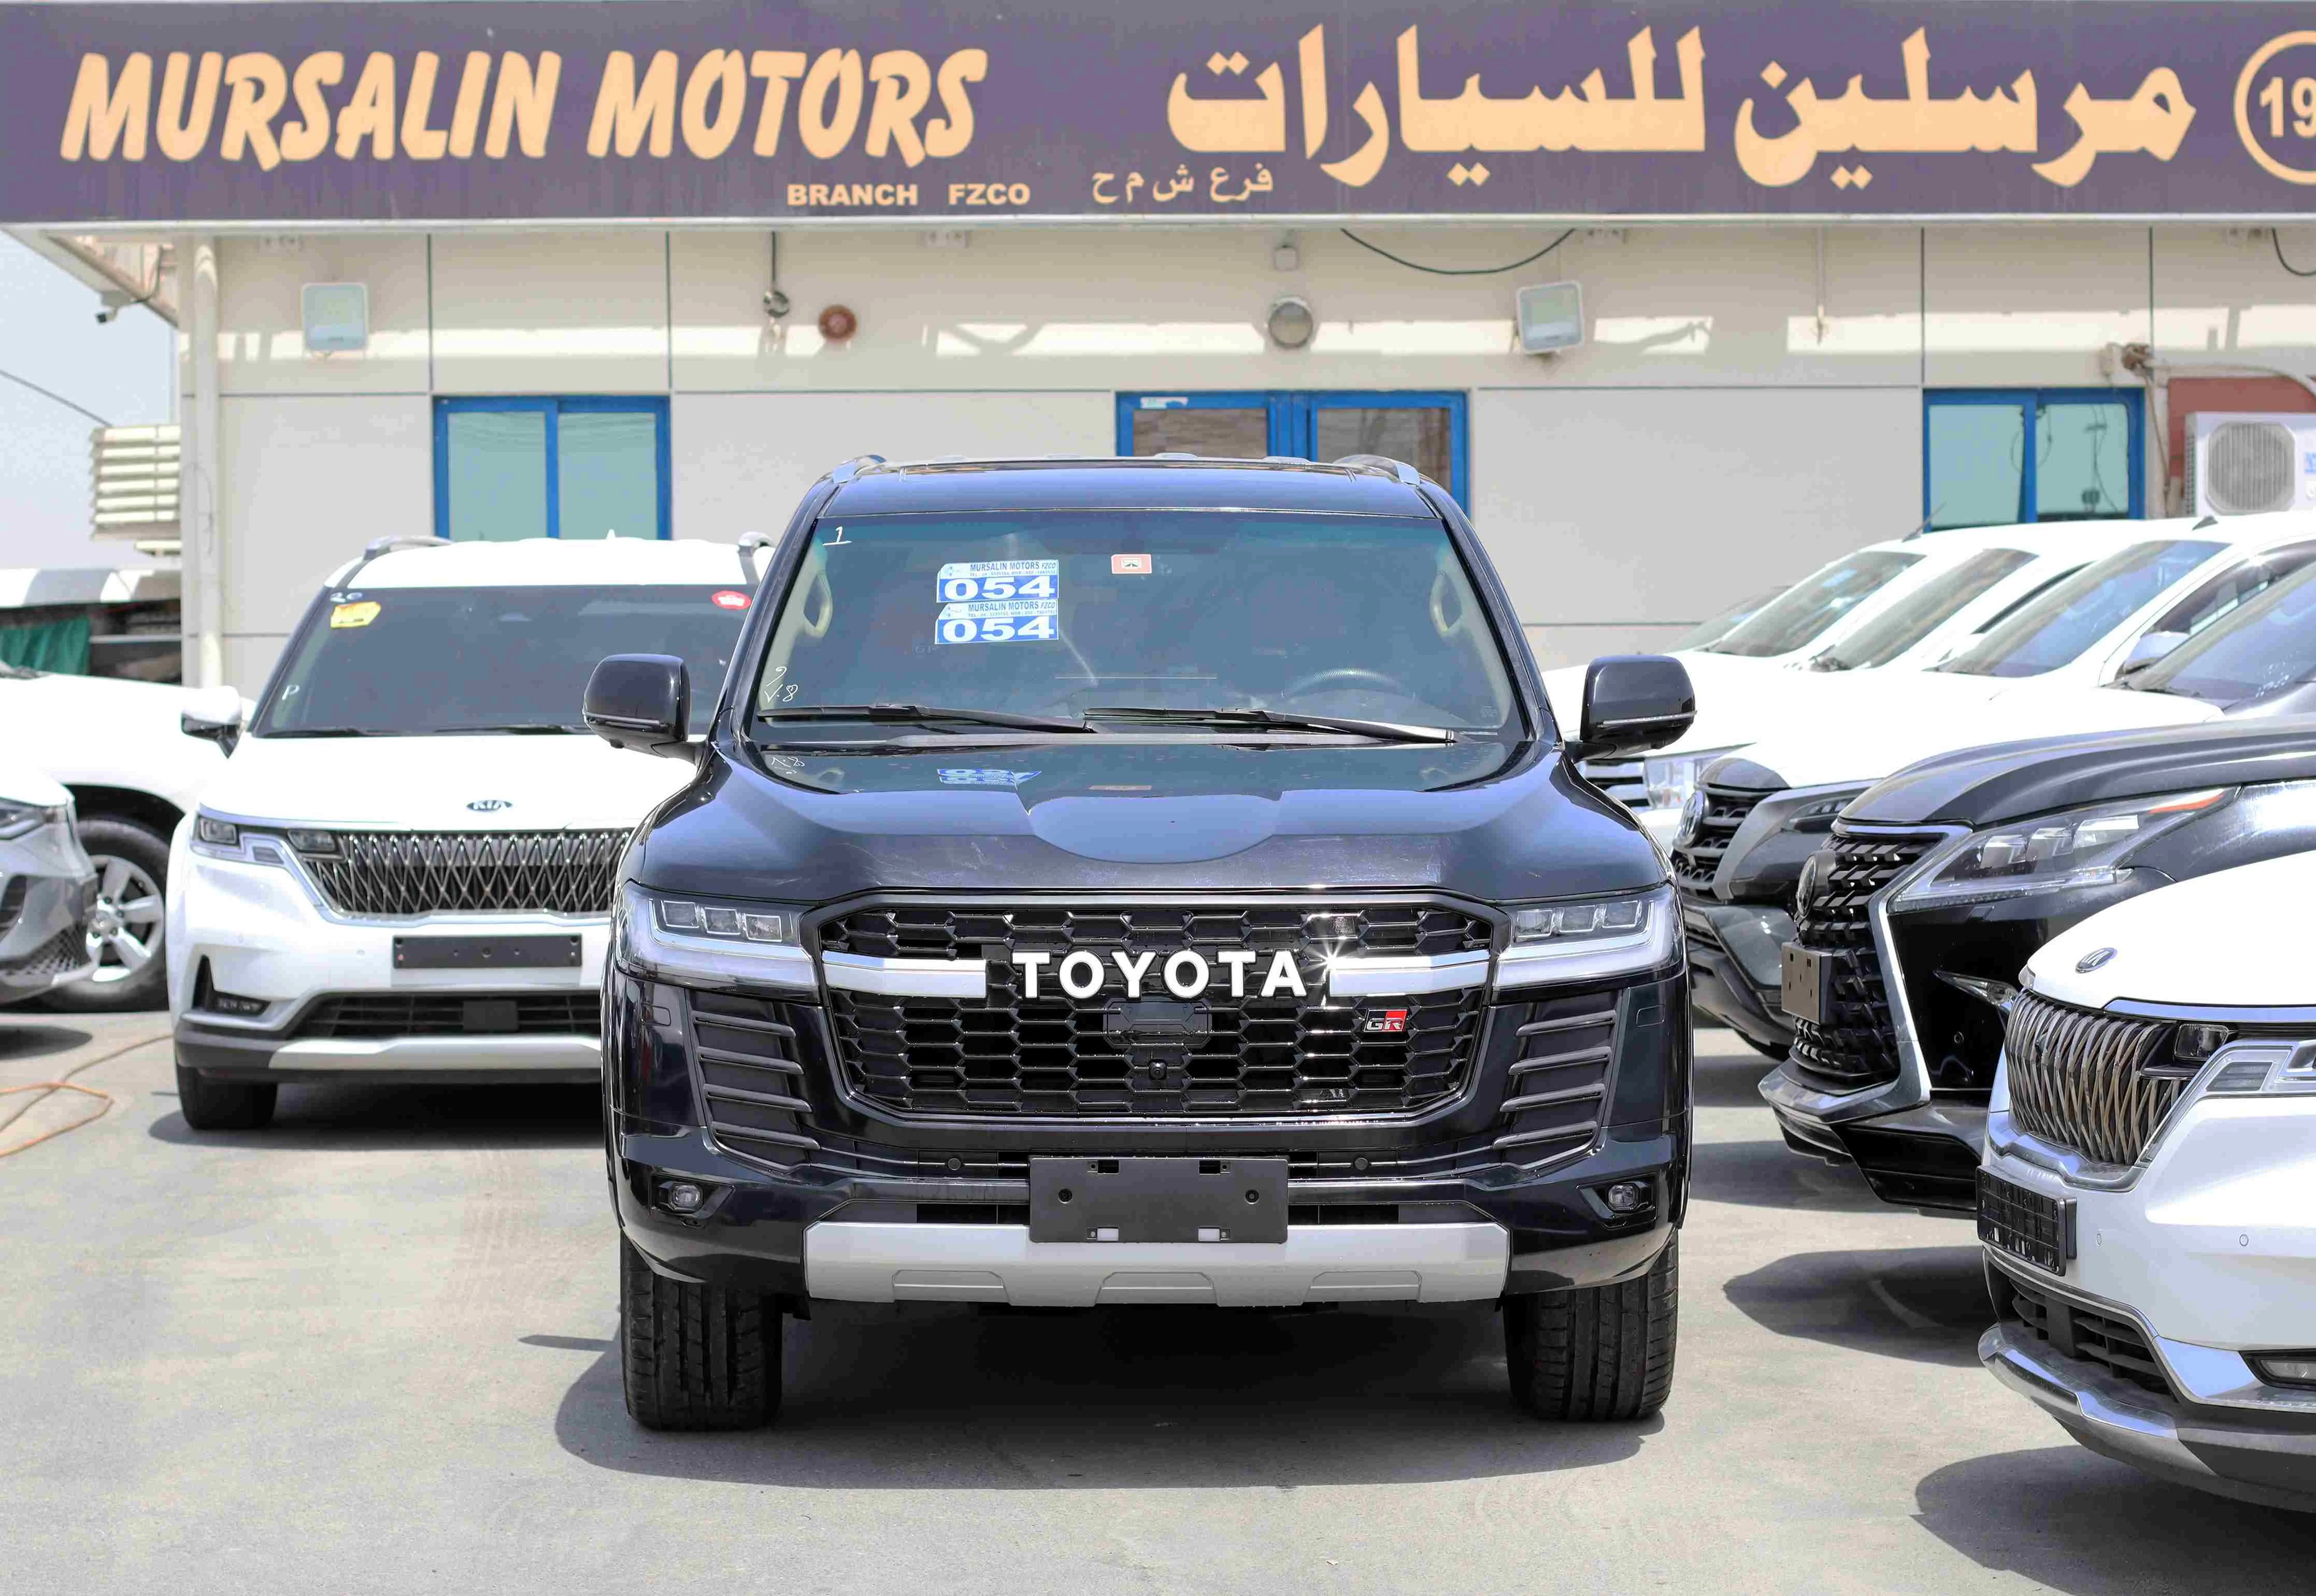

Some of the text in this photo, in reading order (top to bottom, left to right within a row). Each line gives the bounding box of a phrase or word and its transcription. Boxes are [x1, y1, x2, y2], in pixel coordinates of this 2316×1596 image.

[61, 49, 988, 171] MURSALIN MOTORS
[1168, 24, 2195, 188] مرسلين للسيارات
[787, 183, 1031, 206] BRANCH FZCO
[1210, 162, 1274, 203] فرع
[970, 563, 1007, 572] MURSALIN
[1009, 562, 1039, 571] MOTORS
[944, 575, 1055, 600] 054
[968, 603, 1006, 612] MURSALIN
[1008, 602, 1039, 610] MOTORS
[942, 616, 1055, 642] 054
[1012, 949, 1307, 999] TOYOTA
[1366, 1017, 1404, 1031] GR
